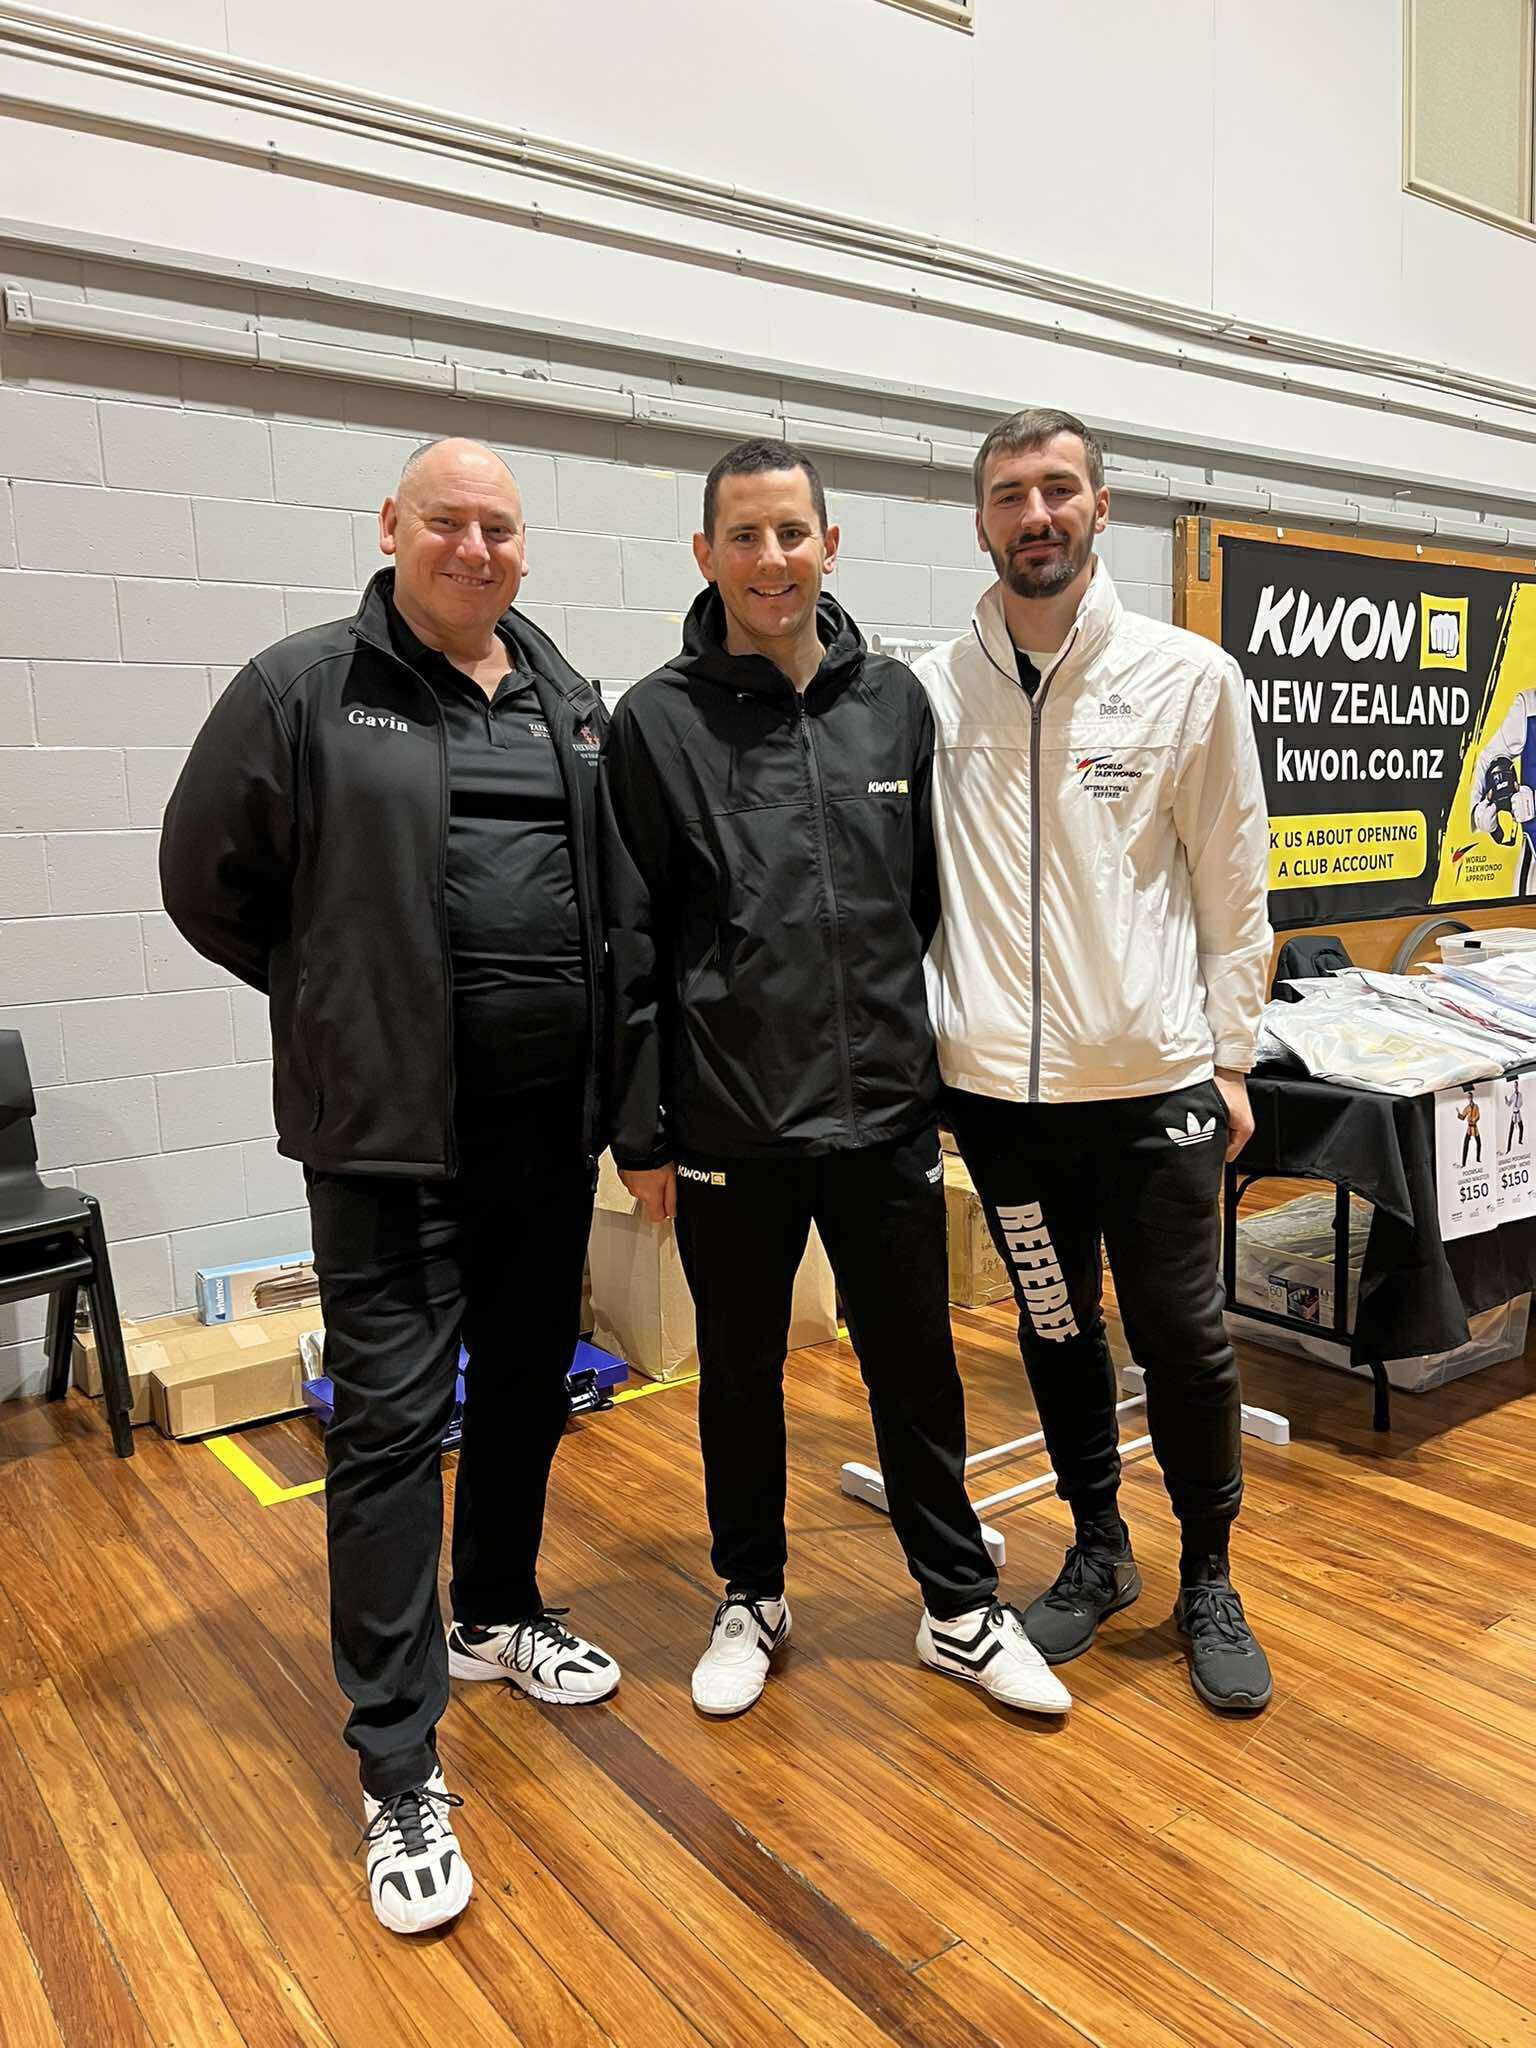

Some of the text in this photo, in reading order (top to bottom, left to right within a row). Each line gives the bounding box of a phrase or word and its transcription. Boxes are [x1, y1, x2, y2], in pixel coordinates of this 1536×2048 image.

[1247, 584, 1416, 662] KWON
[1245, 678, 1470, 726] NEW ZEALAND
[348, 709, 408, 733] Gavin
[1276, 737, 1444, 782] kwon.co.nz
[1094, 770, 1142, 778] TAEKWONDO
[867, 781, 897, 793] KWON
[1284, 831, 1303, 848] US
[1306, 828, 1353, 847] ABOUT
[1357, 825, 1418, 844] OPENING
[1278, 853, 1395, 877] A CLUB ACCOUNT
[1465, 855, 1488, 864] WORLD
[1465, 863, 1503, 873] TAEKWONDO
[1465, 873, 1496, 882] APPROVED
[677, 1164, 711, 1183] KWON
[1501, 1170, 1529, 1189] $150
[1459, 1182, 1489, 1203] $150
